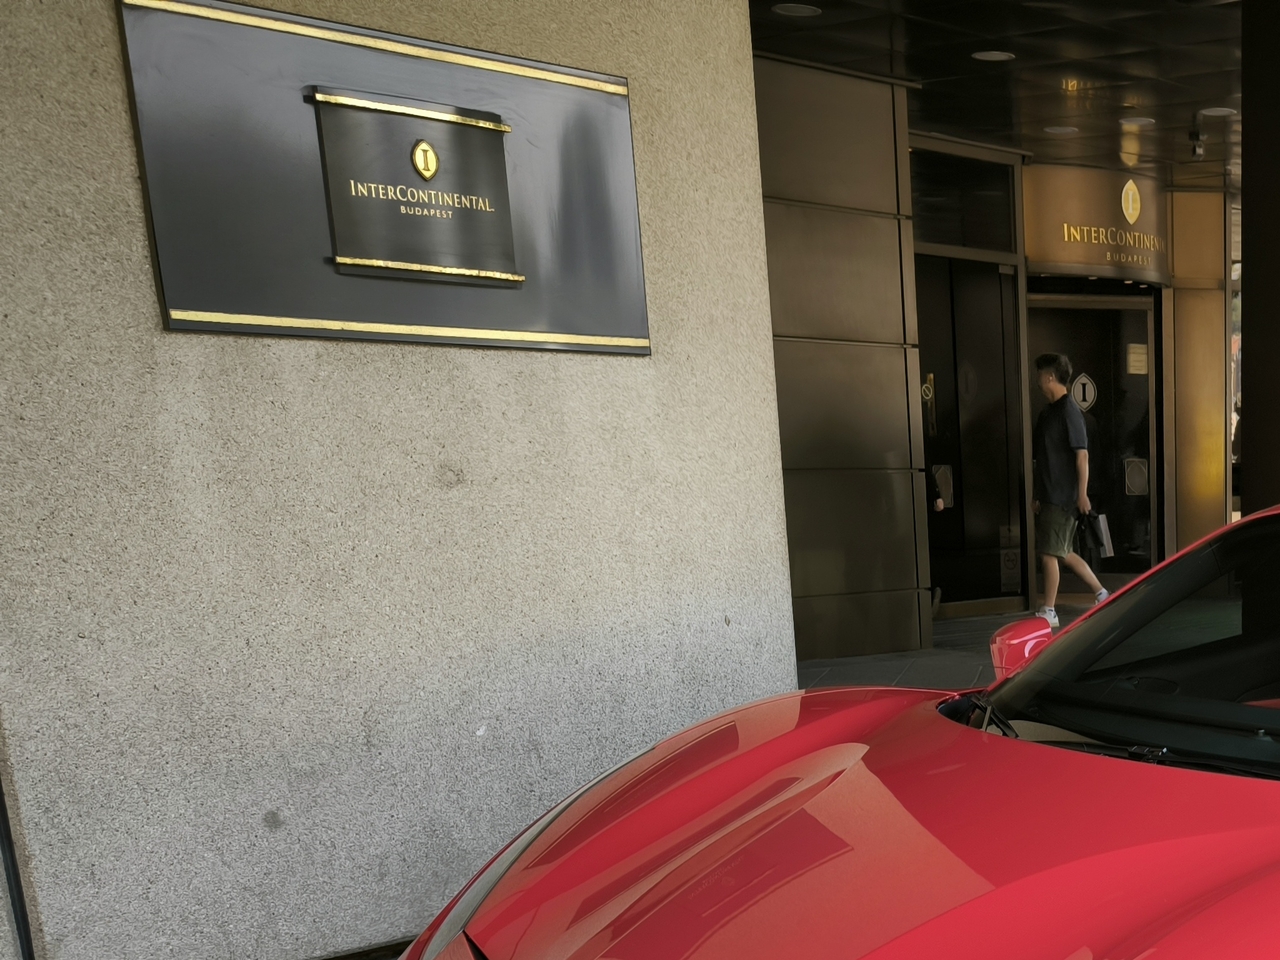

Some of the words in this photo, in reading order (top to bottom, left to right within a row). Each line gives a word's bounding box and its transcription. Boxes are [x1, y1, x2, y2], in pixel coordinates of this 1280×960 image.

[350, 179, 494, 212] INTERCONTINENTAL
[400, 205, 453, 219] BUDAPEST
[1106, 252, 1151, 266] BUDAPEST
